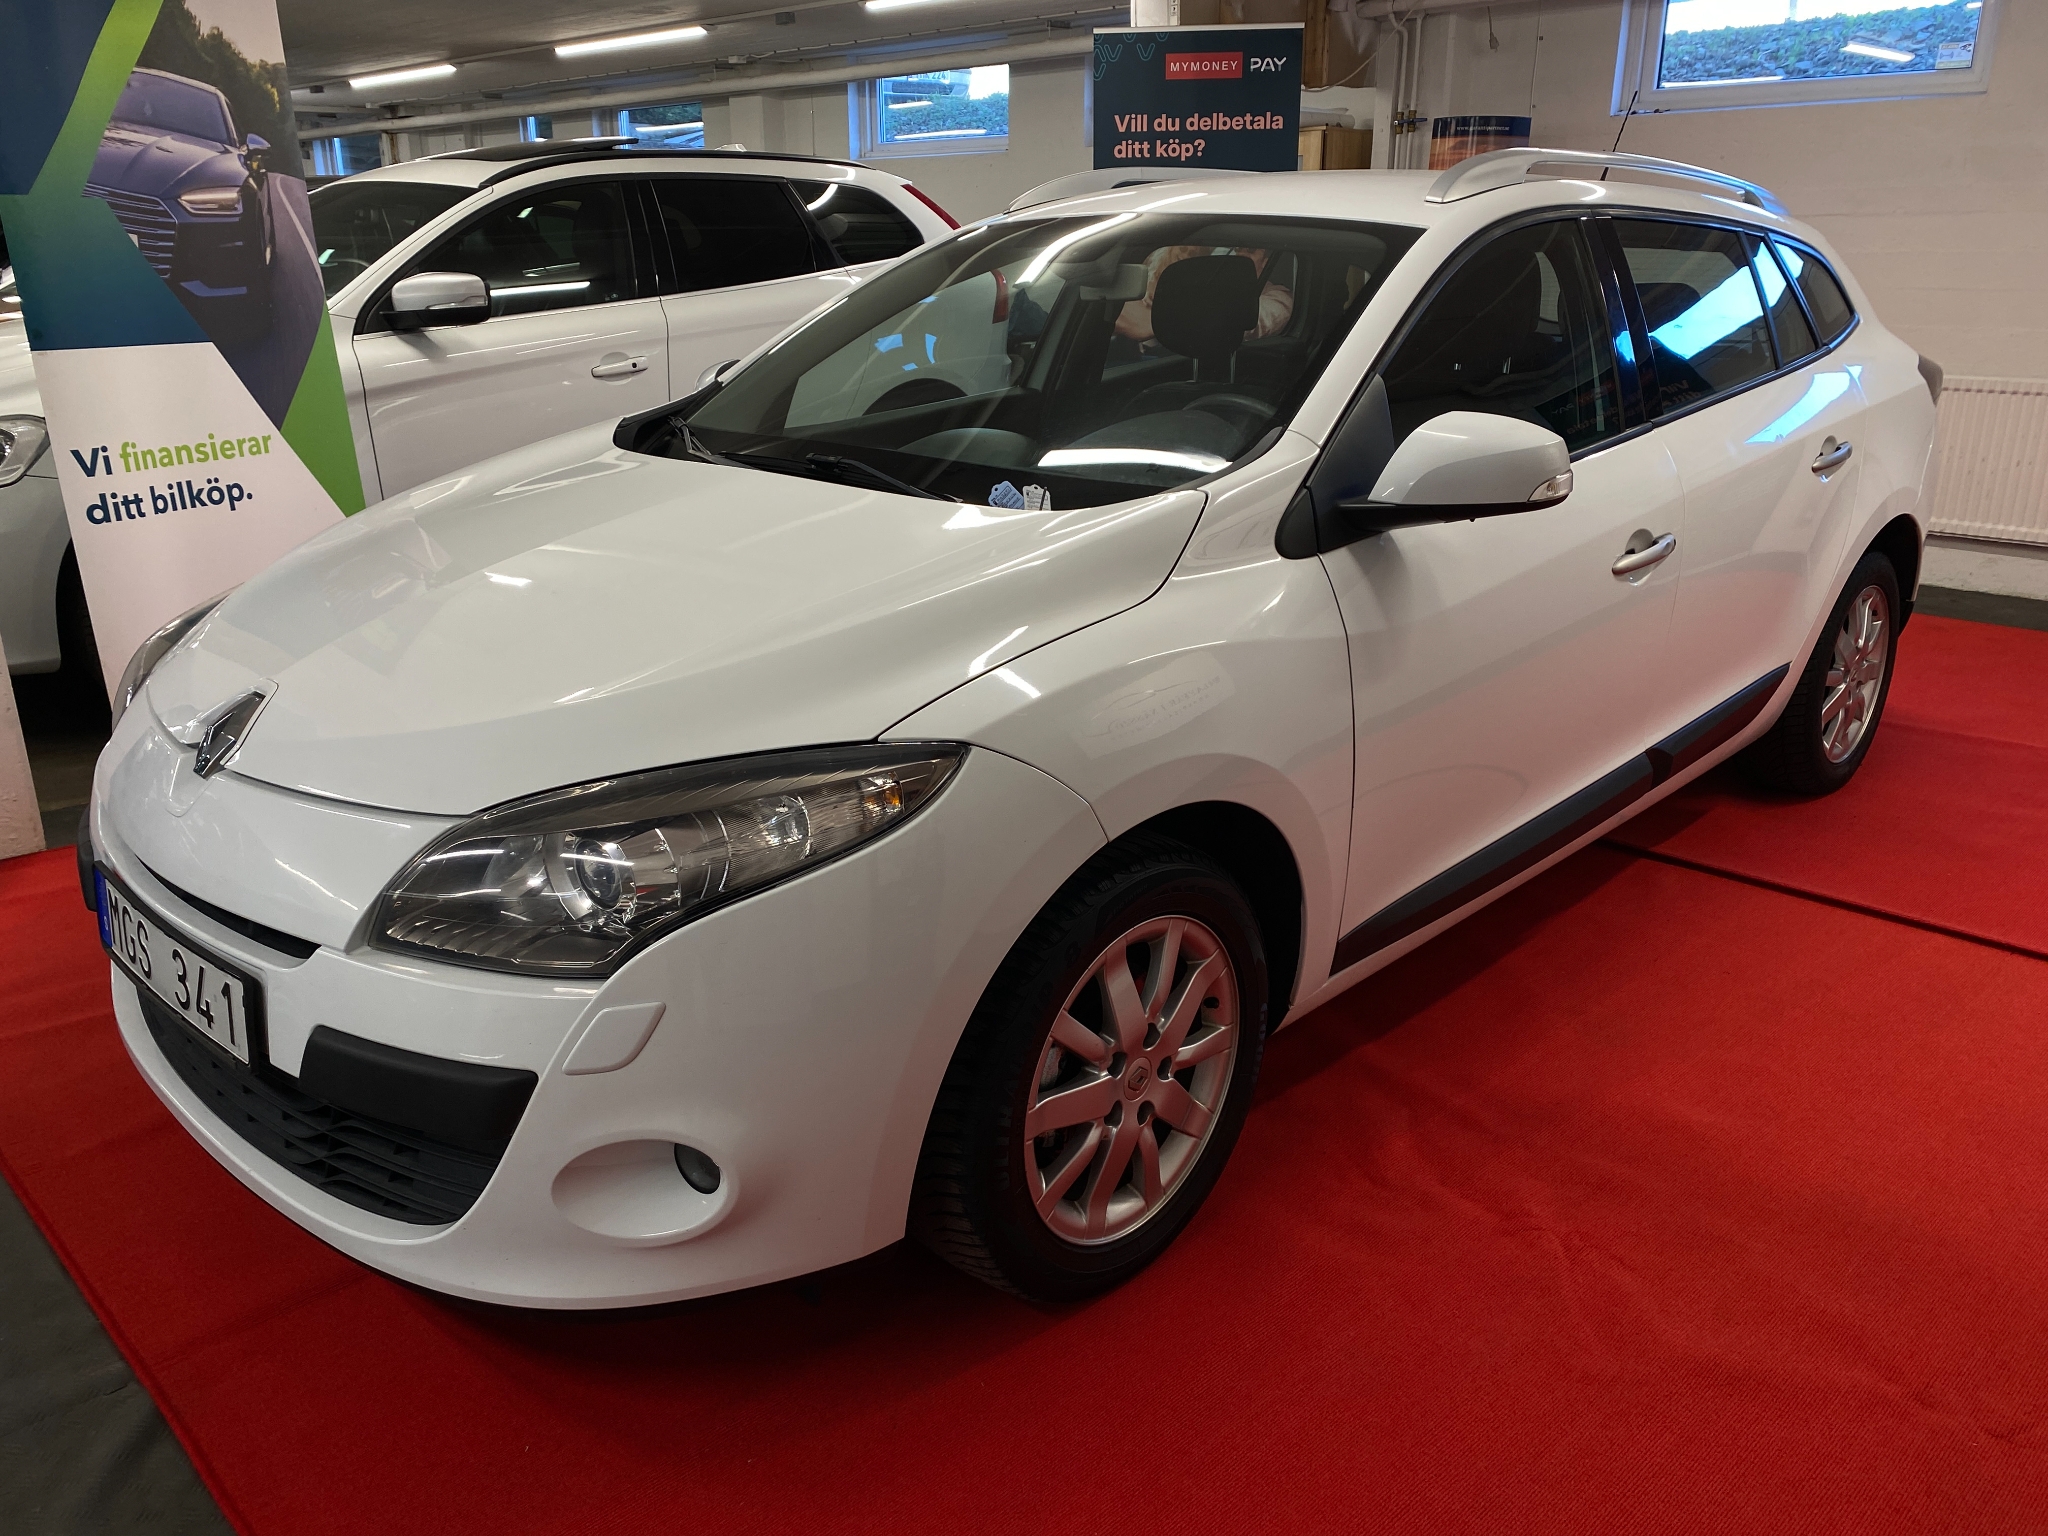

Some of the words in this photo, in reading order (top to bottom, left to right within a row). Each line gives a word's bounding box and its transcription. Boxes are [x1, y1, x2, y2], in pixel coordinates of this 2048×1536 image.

[1170, 60, 1238, 72] MYMONEY
[1250, 56, 1287, 72] PAY
[1114, 113, 1148, 132] Vill
[1153, 113, 1180, 131] du
[1185, 112, 1284, 131] delbetala
[1113, 140, 1151, 158] ditt
[1155, 138, 1206, 161] köp?
[69, 445, 113, 478] Vi
[119, 432, 272, 473] finansierar
[85, 492, 146, 525] ditt
[149, 477, 253, 515] bilköp.
[107, 888, 152, 980] MGS
[172, 948, 236, 1047] 341
